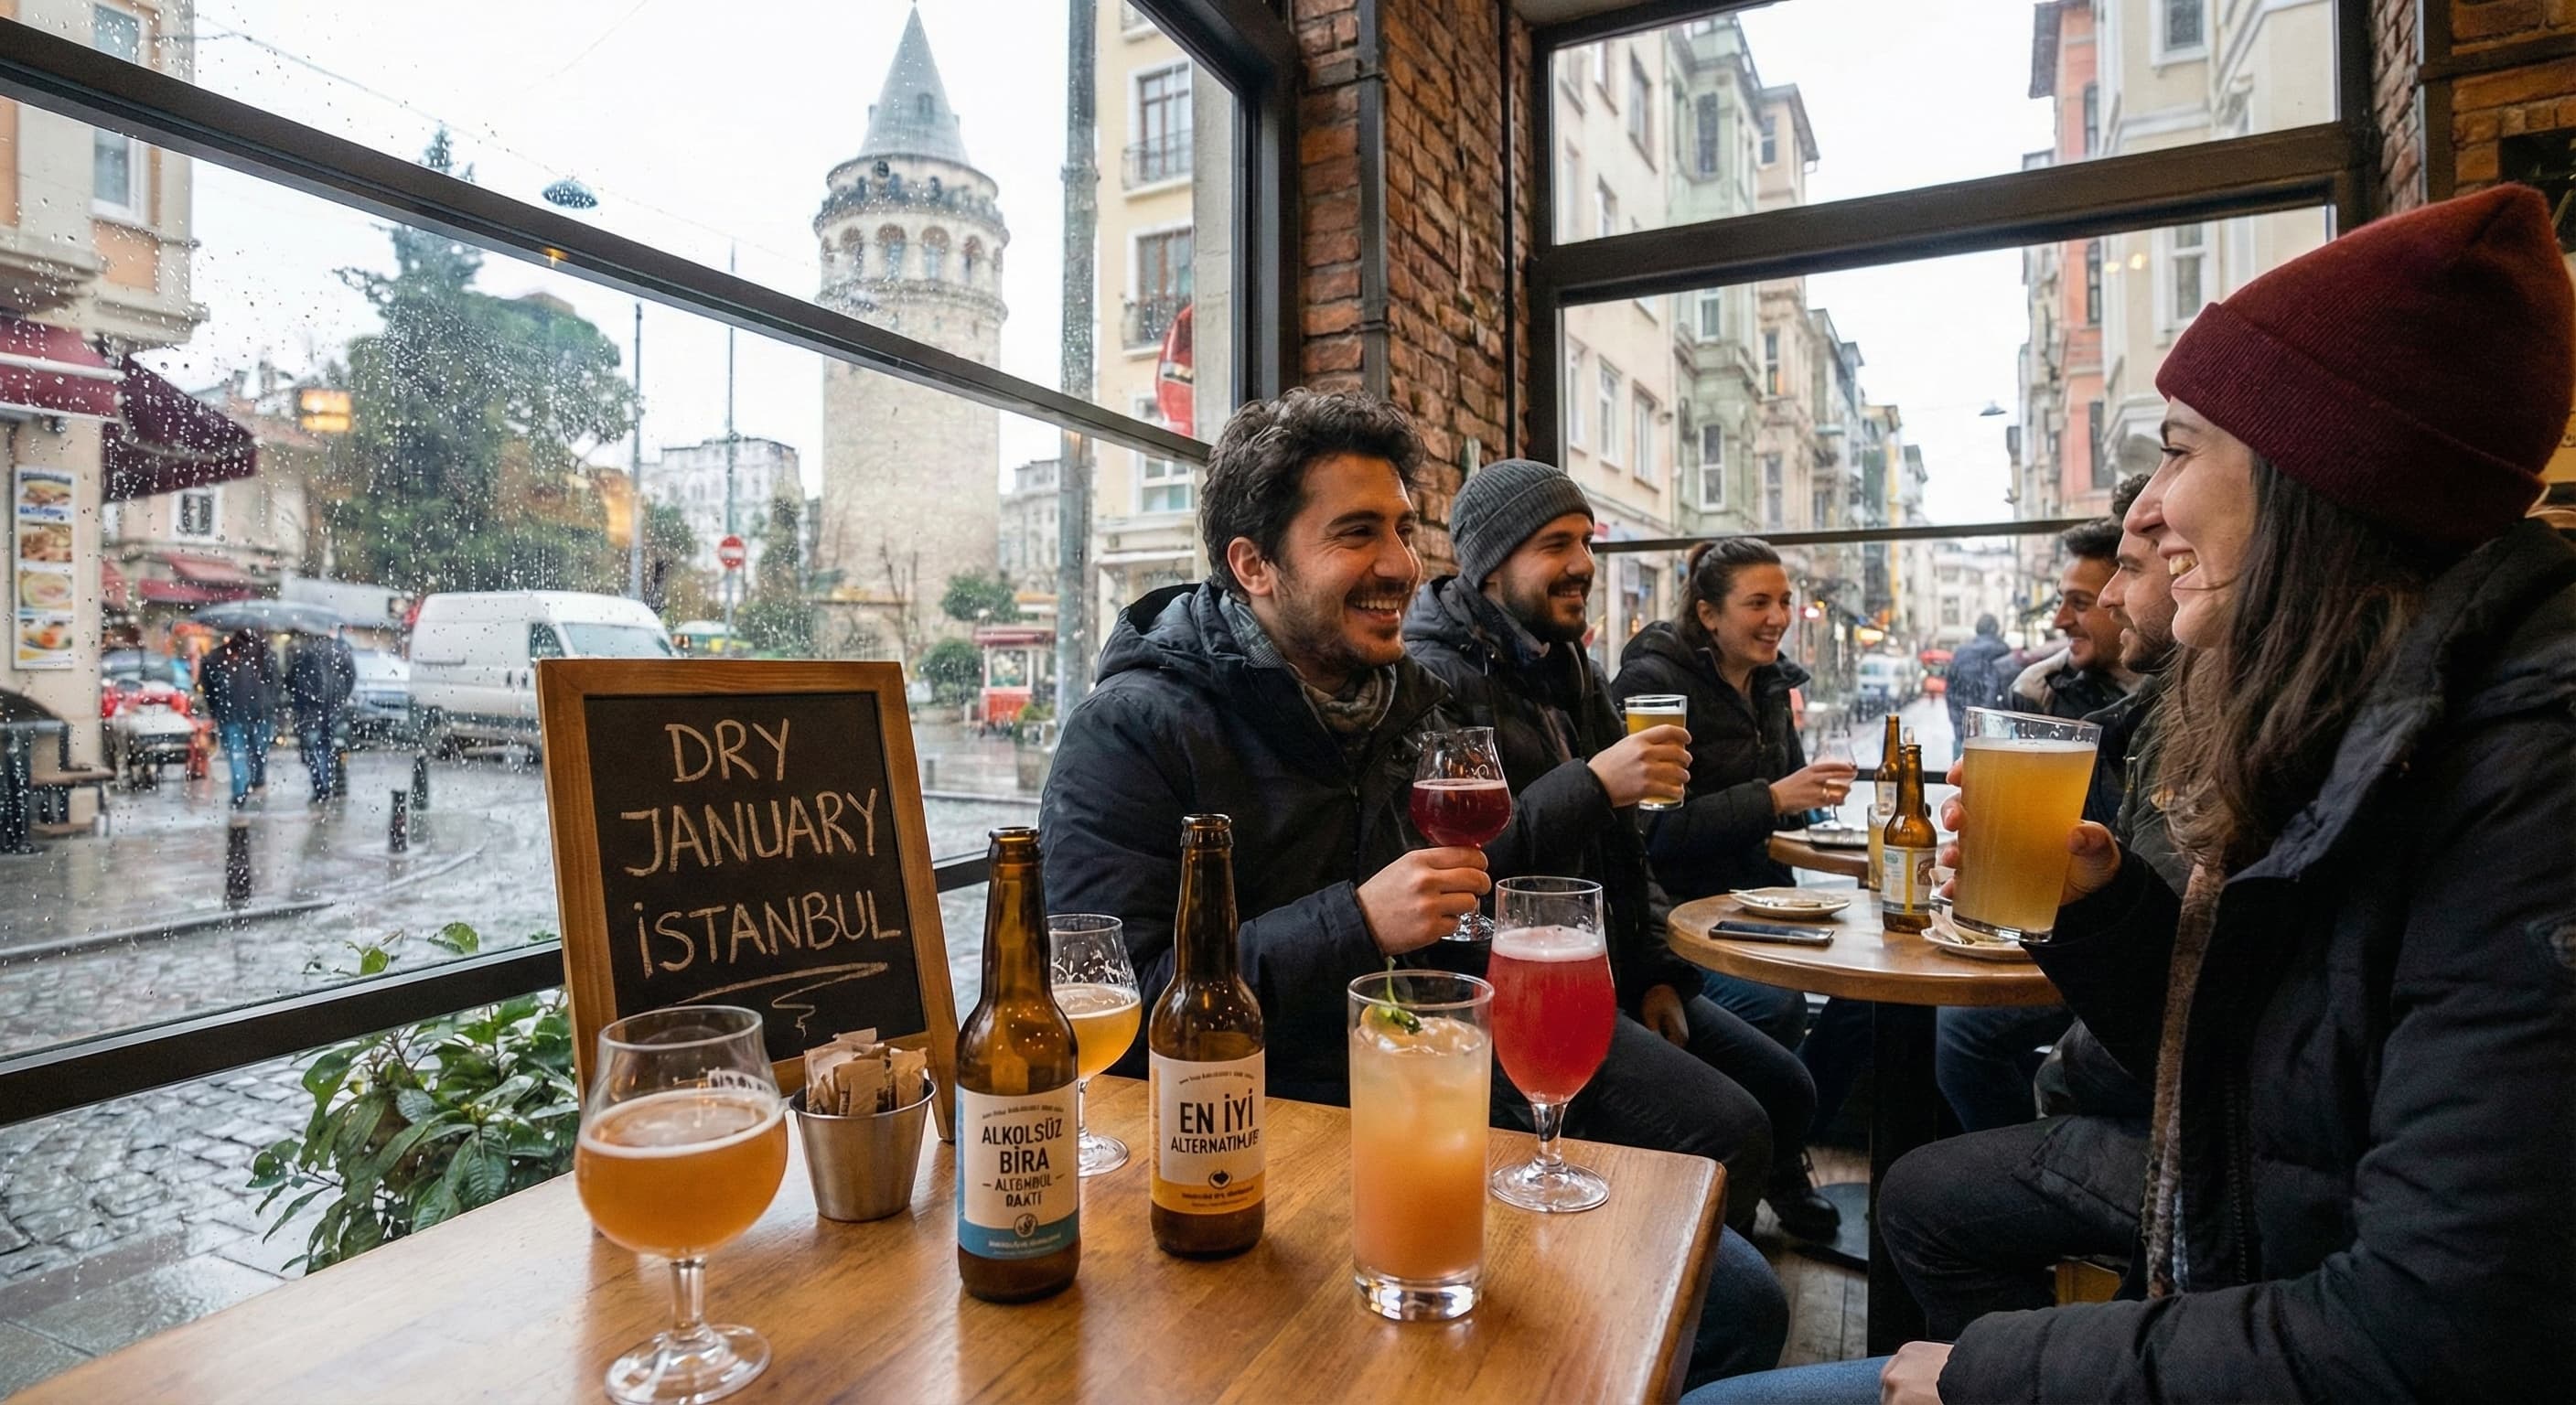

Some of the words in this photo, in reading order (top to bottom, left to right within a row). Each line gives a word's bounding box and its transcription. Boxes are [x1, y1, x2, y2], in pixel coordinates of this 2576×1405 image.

[665, 718, 789, 782] DRY
[621, 788, 878, 877] JANUARY
[634, 890, 901, 979] İSTANBUL
[982, 1117, 1062, 1145] ALKOLSÜZ
[1180, 1102, 1214, 1134] EN
[1224, 1088, 1253, 1132] İYİ
[1000, 1146, 1049, 1174] BİRA
